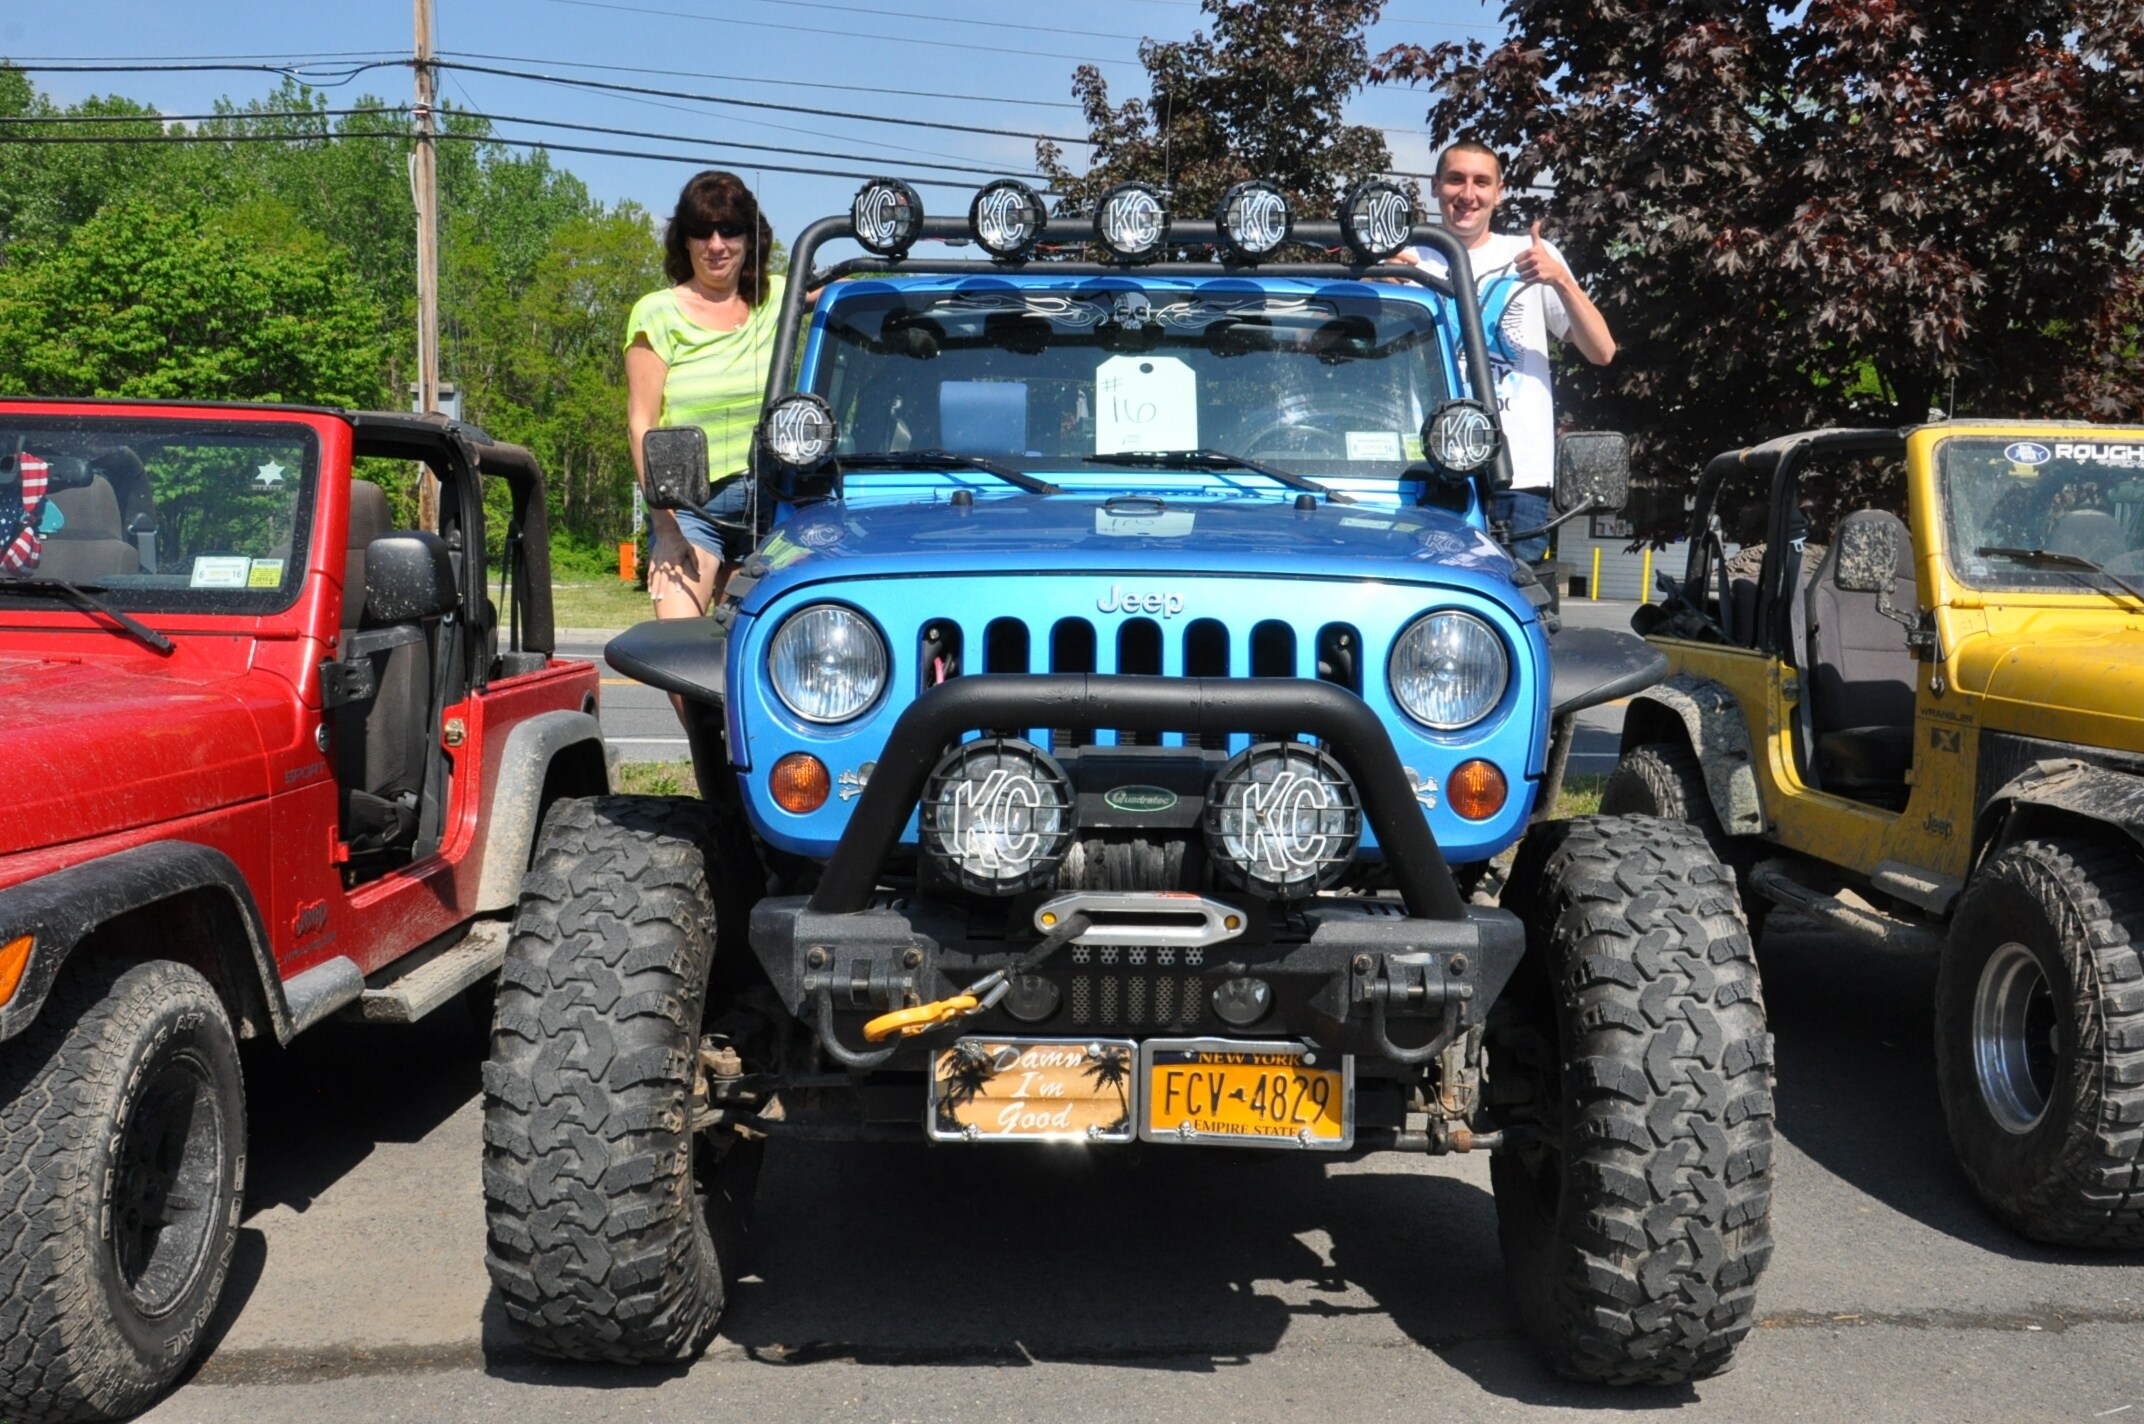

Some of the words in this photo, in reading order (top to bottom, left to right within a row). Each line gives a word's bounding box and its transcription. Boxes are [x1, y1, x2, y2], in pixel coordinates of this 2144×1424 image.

[856, 186, 896, 242] KC
[978, 188, 1023, 244] KC
[1110, 191, 1158, 247] KC
[1241, 191, 1285, 247] KC
[1369, 191, 1409, 247] KC
[1101, 376, 1124, 392] #
[1113, 396, 1156, 423] 16
[773, 403, 822, 459] KC
[1442, 409, 1491, 466] KC
[2055, 444, 2144, 460] ROUGH
[1096, 585, 1185, 620] Jeep
[284, 760, 327, 784] SPORT
[1111, 790, 1170, 805] Quadratec
[954, 770, 1040, 869] KC
[1243, 772, 1327, 871] KC
[1922, 811, 1953, 840] Jeep
[993, 1045, 1082, 1072] Damn
[1198, 1052, 1246, 1065] NEW
[1252, 1053, 1301, 1066] YORK
[1010, 1071, 1065, 1098] I'm
[1164, 1071, 1226, 1117] FCV
[1249, 1073, 1331, 1125] 4829
[997, 1101, 1074, 1134] Good
[1194, 1119, 1249, 1135] EMPIRE
[1253, 1125, 1298, 1137] STATE
[163, 1155, 246, 1356] GENERAL
